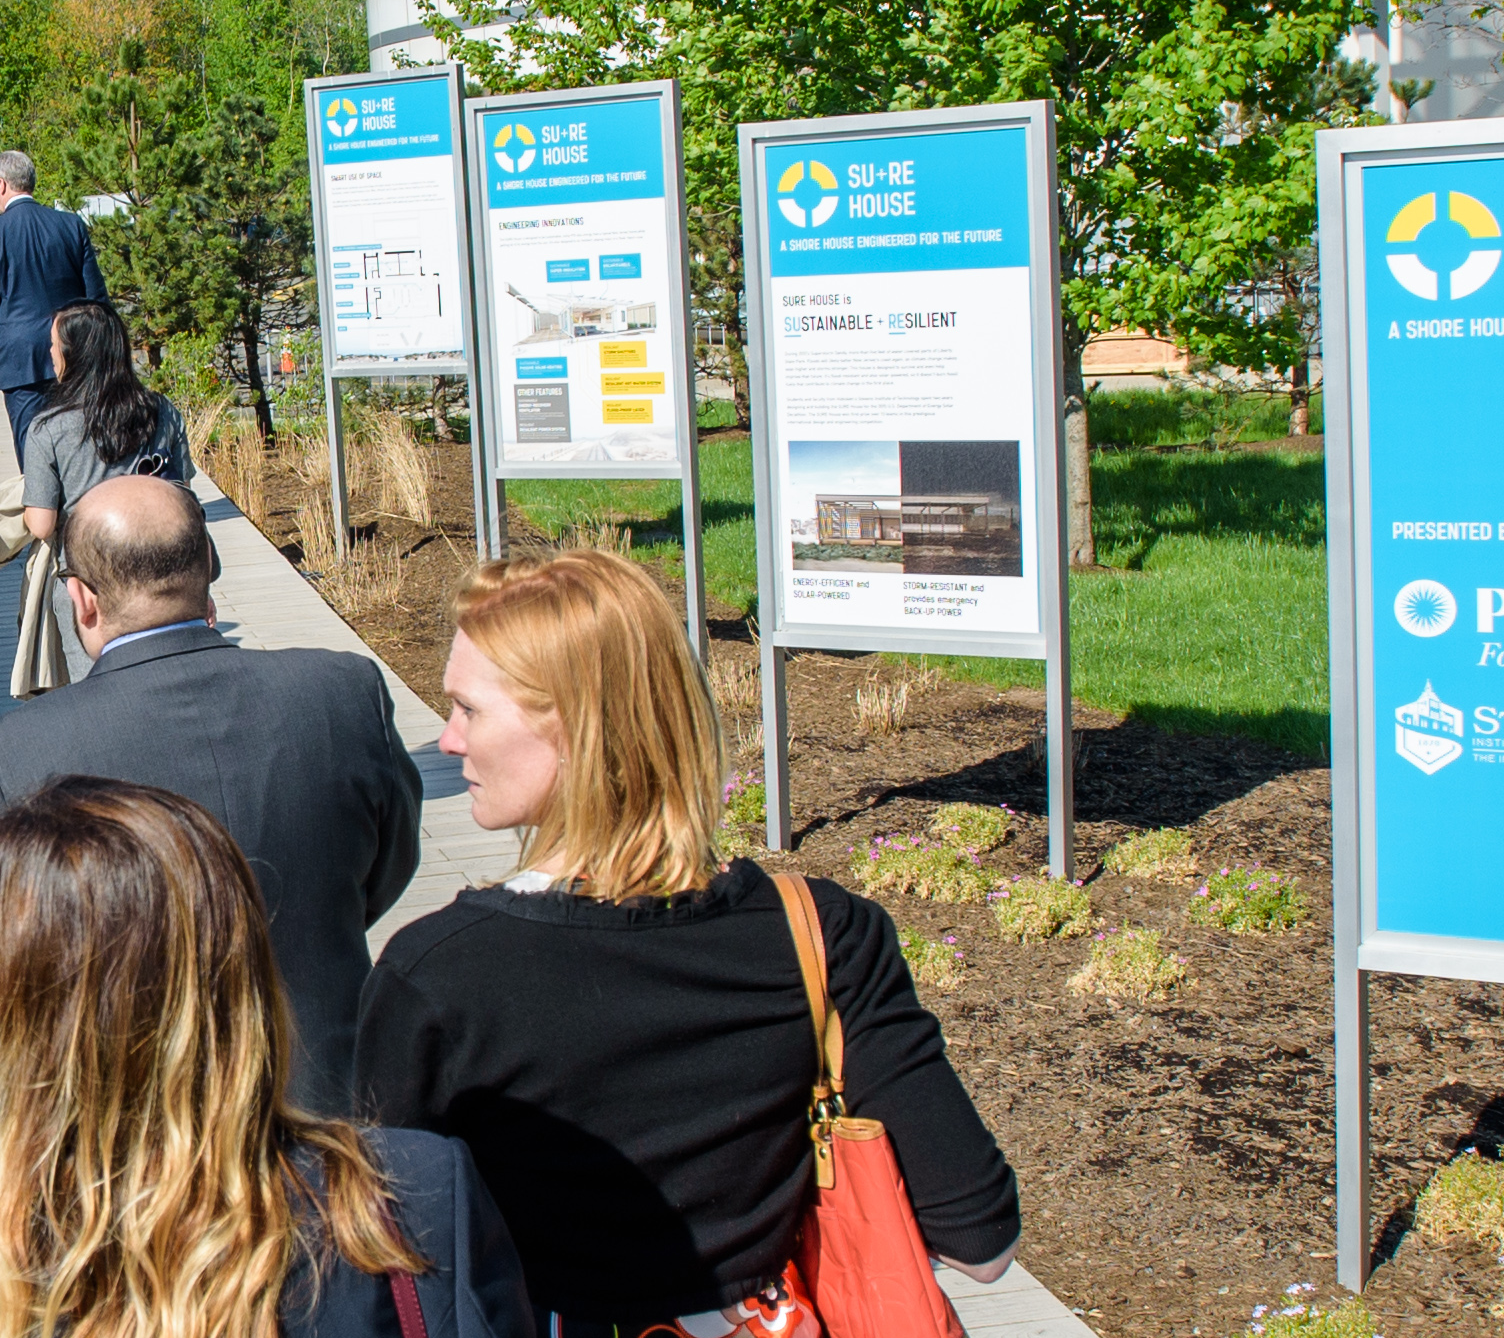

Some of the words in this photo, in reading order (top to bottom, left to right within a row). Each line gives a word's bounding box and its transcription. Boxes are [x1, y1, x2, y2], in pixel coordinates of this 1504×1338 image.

[361, 97, 396, 114] SU+RE
[362, 114, 396, 131] HOUSE
[333, 142, 350, 150] SHORE
[350, 140, 366, 149] HOUSE
[367, 138, 398, 148] ENGINEERED
[398, 137, 409, 145] FOR
[409, 135, 419, 144] THE
[419, 134, 440, 143] FUTURE
[542, 123, 588, 144] SU+RE
[542, 145, 589, 166] HOUSE
[496, 182, 501, 191] A
[503, 180, 524, 191] SHORE
[525, 178, 547, 189] HOUSE
[549, 175, 590, 187] ENGINEERED
[591, 174, 605, 184] FOR
[606, 173, 620, 182] THE
[620, 170, 648, 181] FUTURE
[848, 161, 915, 188] SU+RE
[849, 191, 916, 218] HOUSE
[499, 219, 540, 230] ENGINEERING
[542, 217, 584, 227] INNOVATIONS
[780, 240, 788, 252] A
[789, 238, 820, 251] SHORE
[823, 236, 854, 250] HOUSE
[857, 233, 917, 248] ENGINEERED
[919, 231, 939, 245] FOR
[942, 230, 961, 244] THE
[963, 228, 1003, 243] FUTURE
[782, 295, 806, 307] SURE
[809, 294, 840, 306] HOUSE
[843, 294, 852, 305] is
[784, 314, 873, 333] SUSTAINABLE
[888, 311, 957, 329] RESILIENT
[1387, 319, 1400, 340] A
[1405, 317, 1465, 339] SHORE
[1392, 521, 1492, 541] PRESENTED
[793, 578, 854, 588] ENERGY-EFFICIENT
[856, 580, 870, 588] and
[903, 581, 968, 592] STORM-RESISTANT
[970, 584, 984, 592] and
[793, 590, 850, 600] SOLAR-POWERED
[903, 594, 935, 604] provides
[937, 596, 978, 606] emergency
[904, 606, 935, 616] BACK-UP
[937, 608, 962, 617] POWER
[1473, 754, 1496, 763] THE
